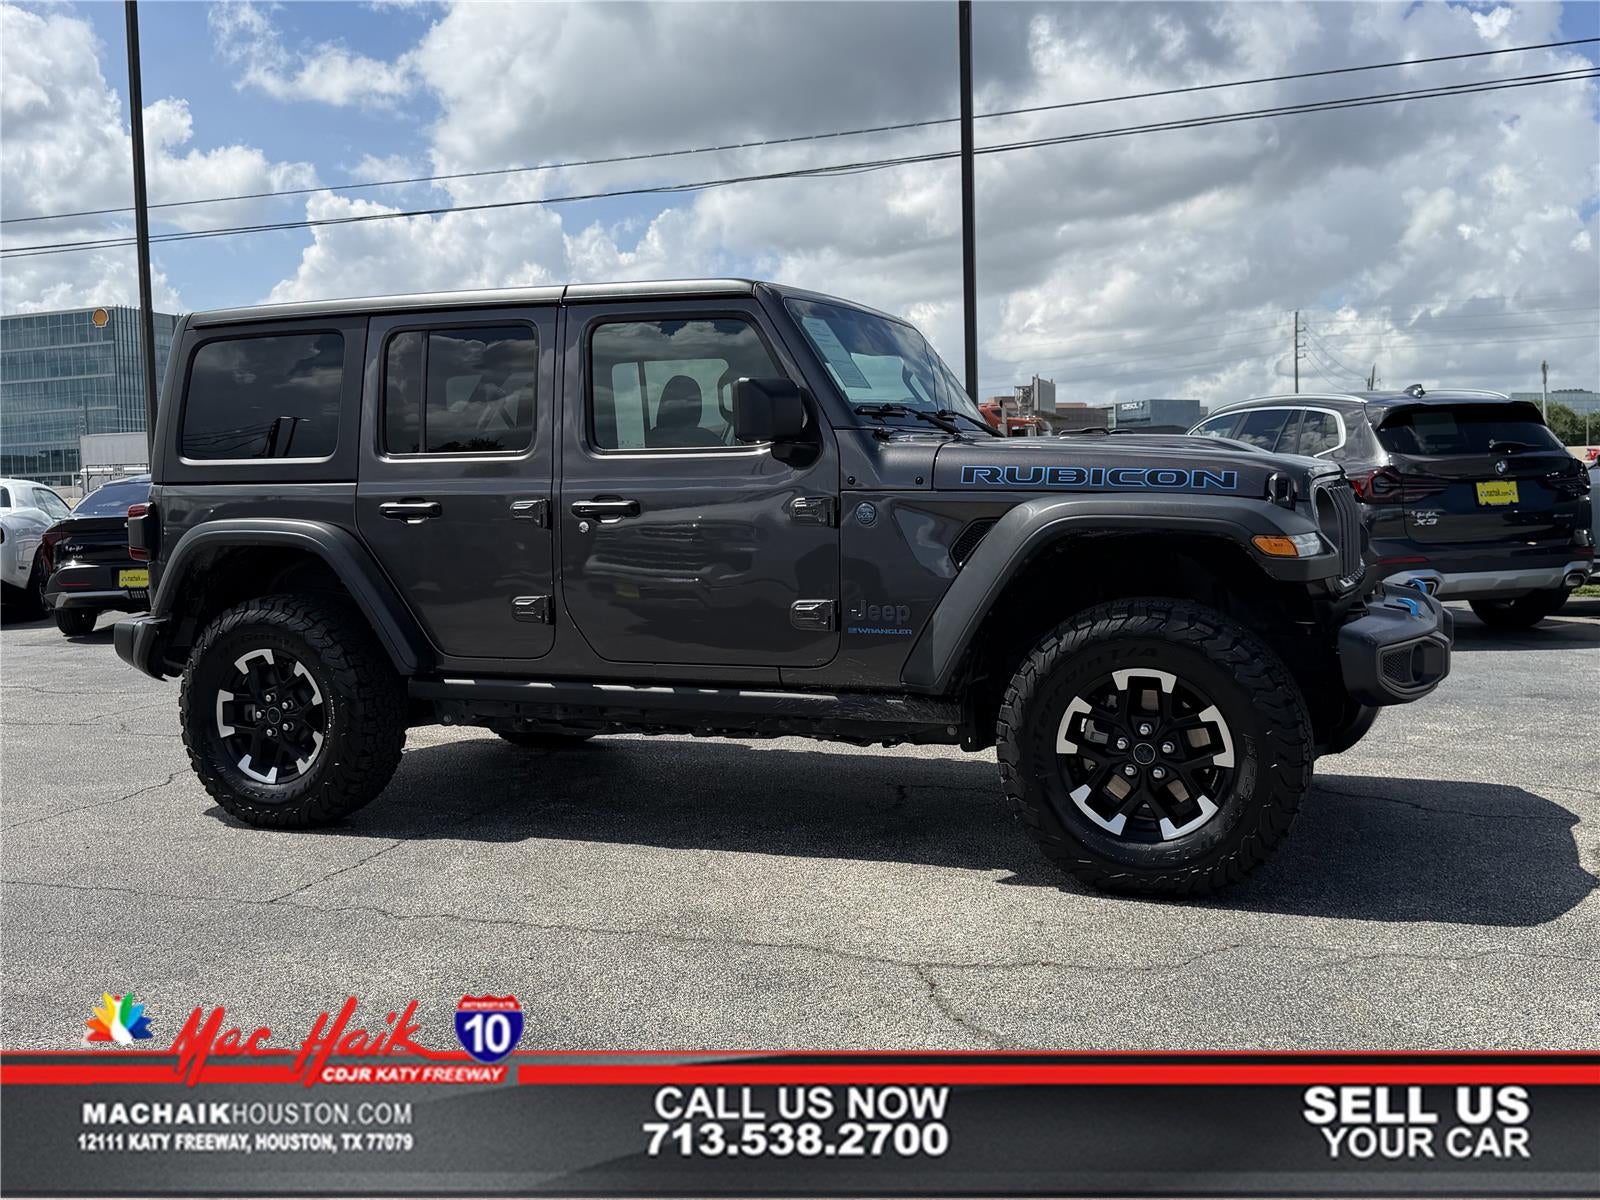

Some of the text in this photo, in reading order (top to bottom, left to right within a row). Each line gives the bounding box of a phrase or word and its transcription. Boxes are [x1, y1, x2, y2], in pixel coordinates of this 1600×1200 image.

[960, 465, 1238, 489] RUBICON
[1413, 518, 1438, 526] X3
[851, 600, 911, 625] Jeep
[857, 627, 912, 635] WRANGLER
